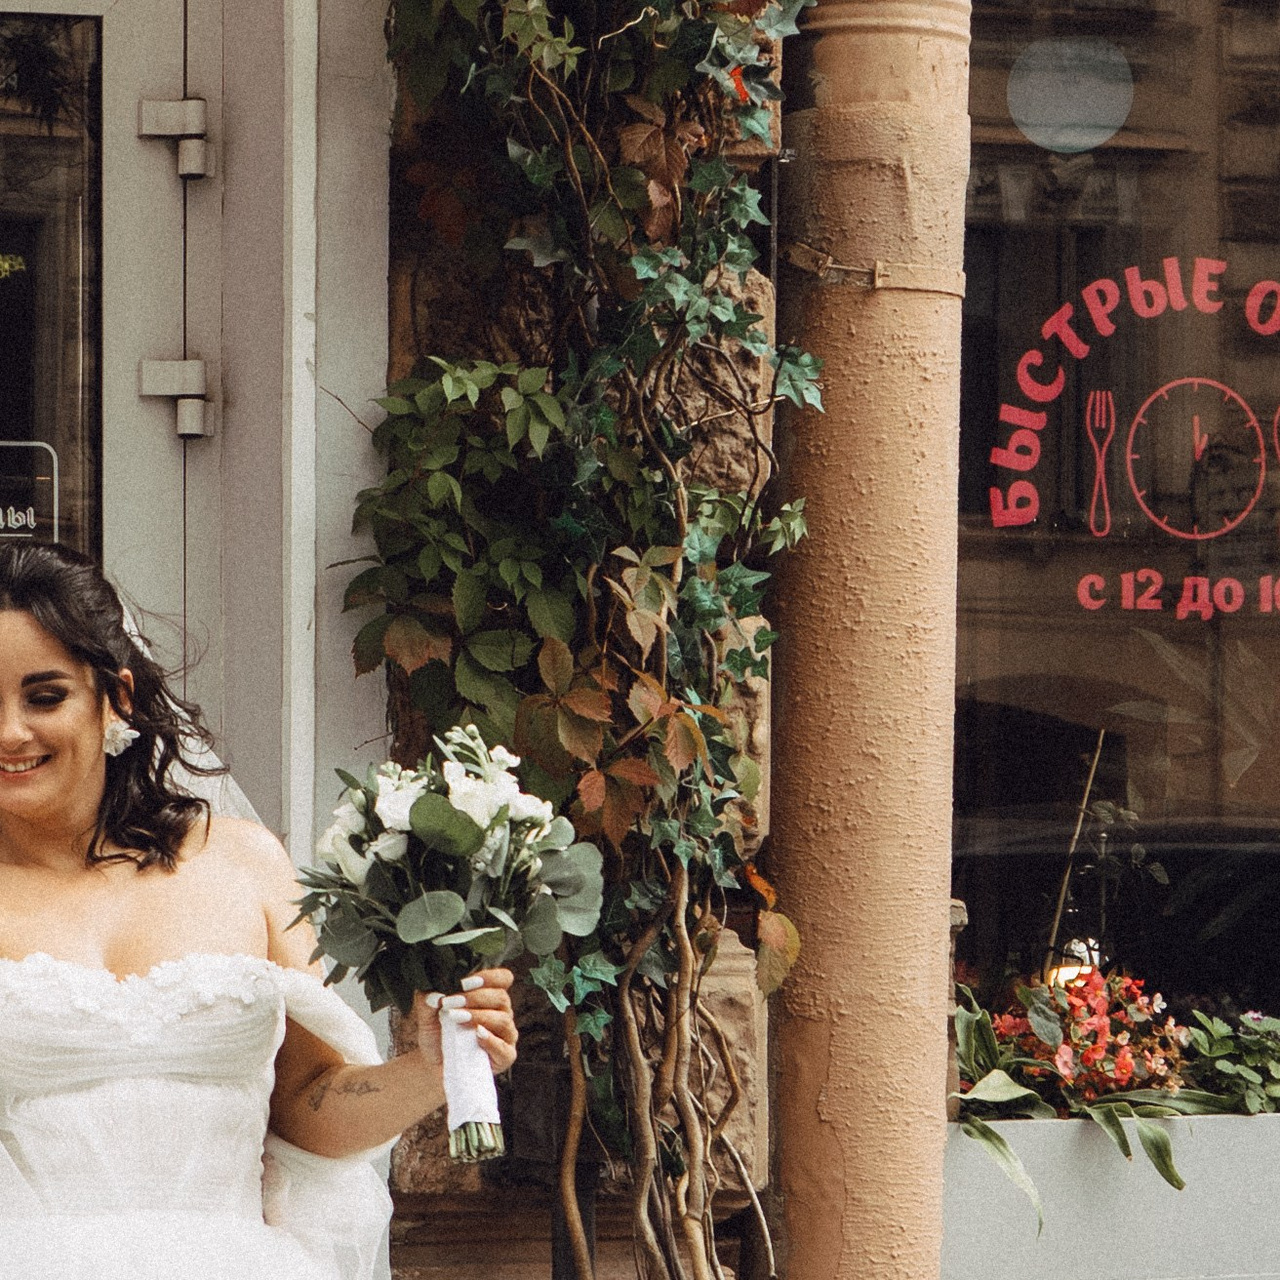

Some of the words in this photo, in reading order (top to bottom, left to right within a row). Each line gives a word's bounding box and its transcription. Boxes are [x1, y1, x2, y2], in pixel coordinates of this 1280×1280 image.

[988, 256, 1228, 527] БЫСТРЫЕ
[1120, 568, 1164, 611] 12
[1259, 575, 1280, 614] 1
